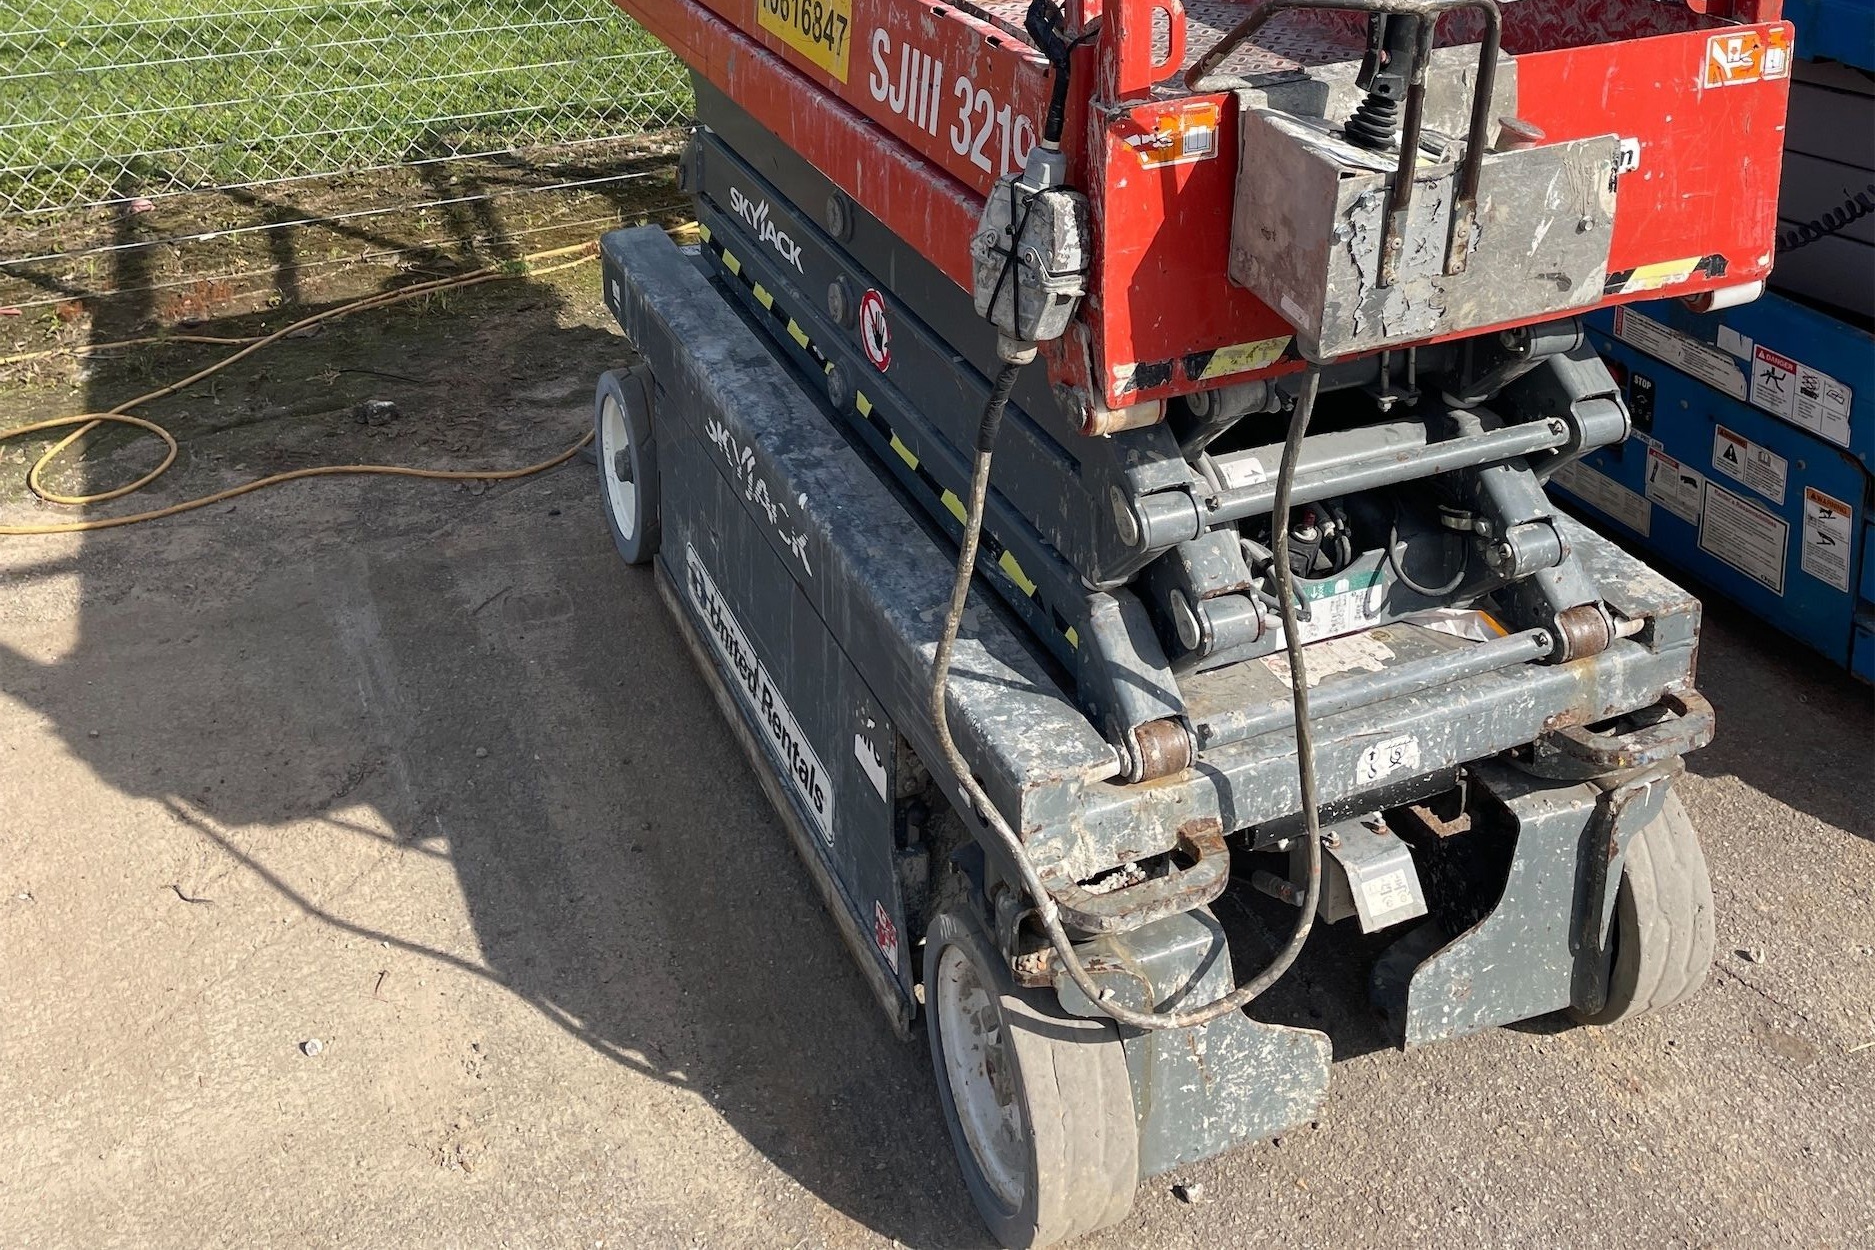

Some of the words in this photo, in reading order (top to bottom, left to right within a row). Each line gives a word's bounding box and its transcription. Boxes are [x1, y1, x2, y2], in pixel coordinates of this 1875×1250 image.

[869, 28, 943, 137] SJIII
[730, 186, 804, 275] SKYJACK
[1634, 374, 1652, 390] STOP
[1765, 353, 1794, 371] DANGER
[710, 593, 758, 700] United
[761, 681, 824, 815] Rentals
